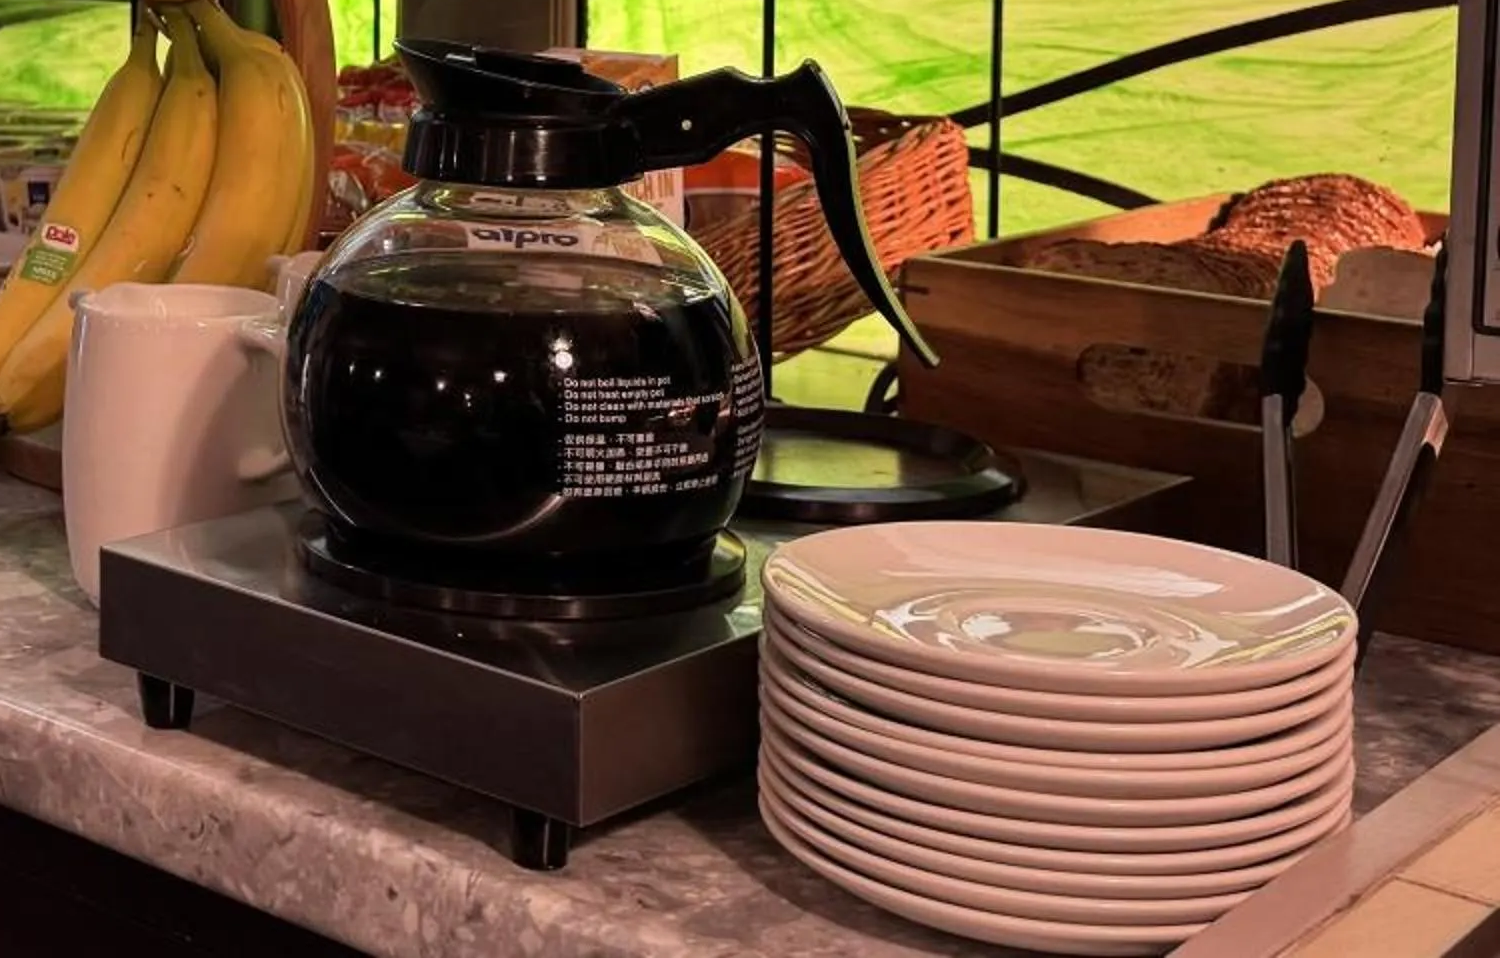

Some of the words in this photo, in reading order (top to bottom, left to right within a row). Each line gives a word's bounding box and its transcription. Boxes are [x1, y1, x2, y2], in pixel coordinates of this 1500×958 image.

[46, 225, 76, 246] Dole
[472, 227, 580, 249] alpro
[564, 377, 579, 388] Do
[580, 377, 597, 388] not
[598, 377, 615, 388] boil
[648, 376, 656, 387] in
[657, 376, 671, 387] pot
[564, 389, 579, 400] Do
[580, 390, 597, 400] not
[598, 389, 621, 400] heat
[564, 401, 580, 412] Do
[581, 402, 597, 412] not
[599, 401, 625, 412] clean
[627, 400, 646, 411] with
[564, 413, 580, 424] Do
[581, 413, 598, 424] not
[599, 413, 627, 425] bump
